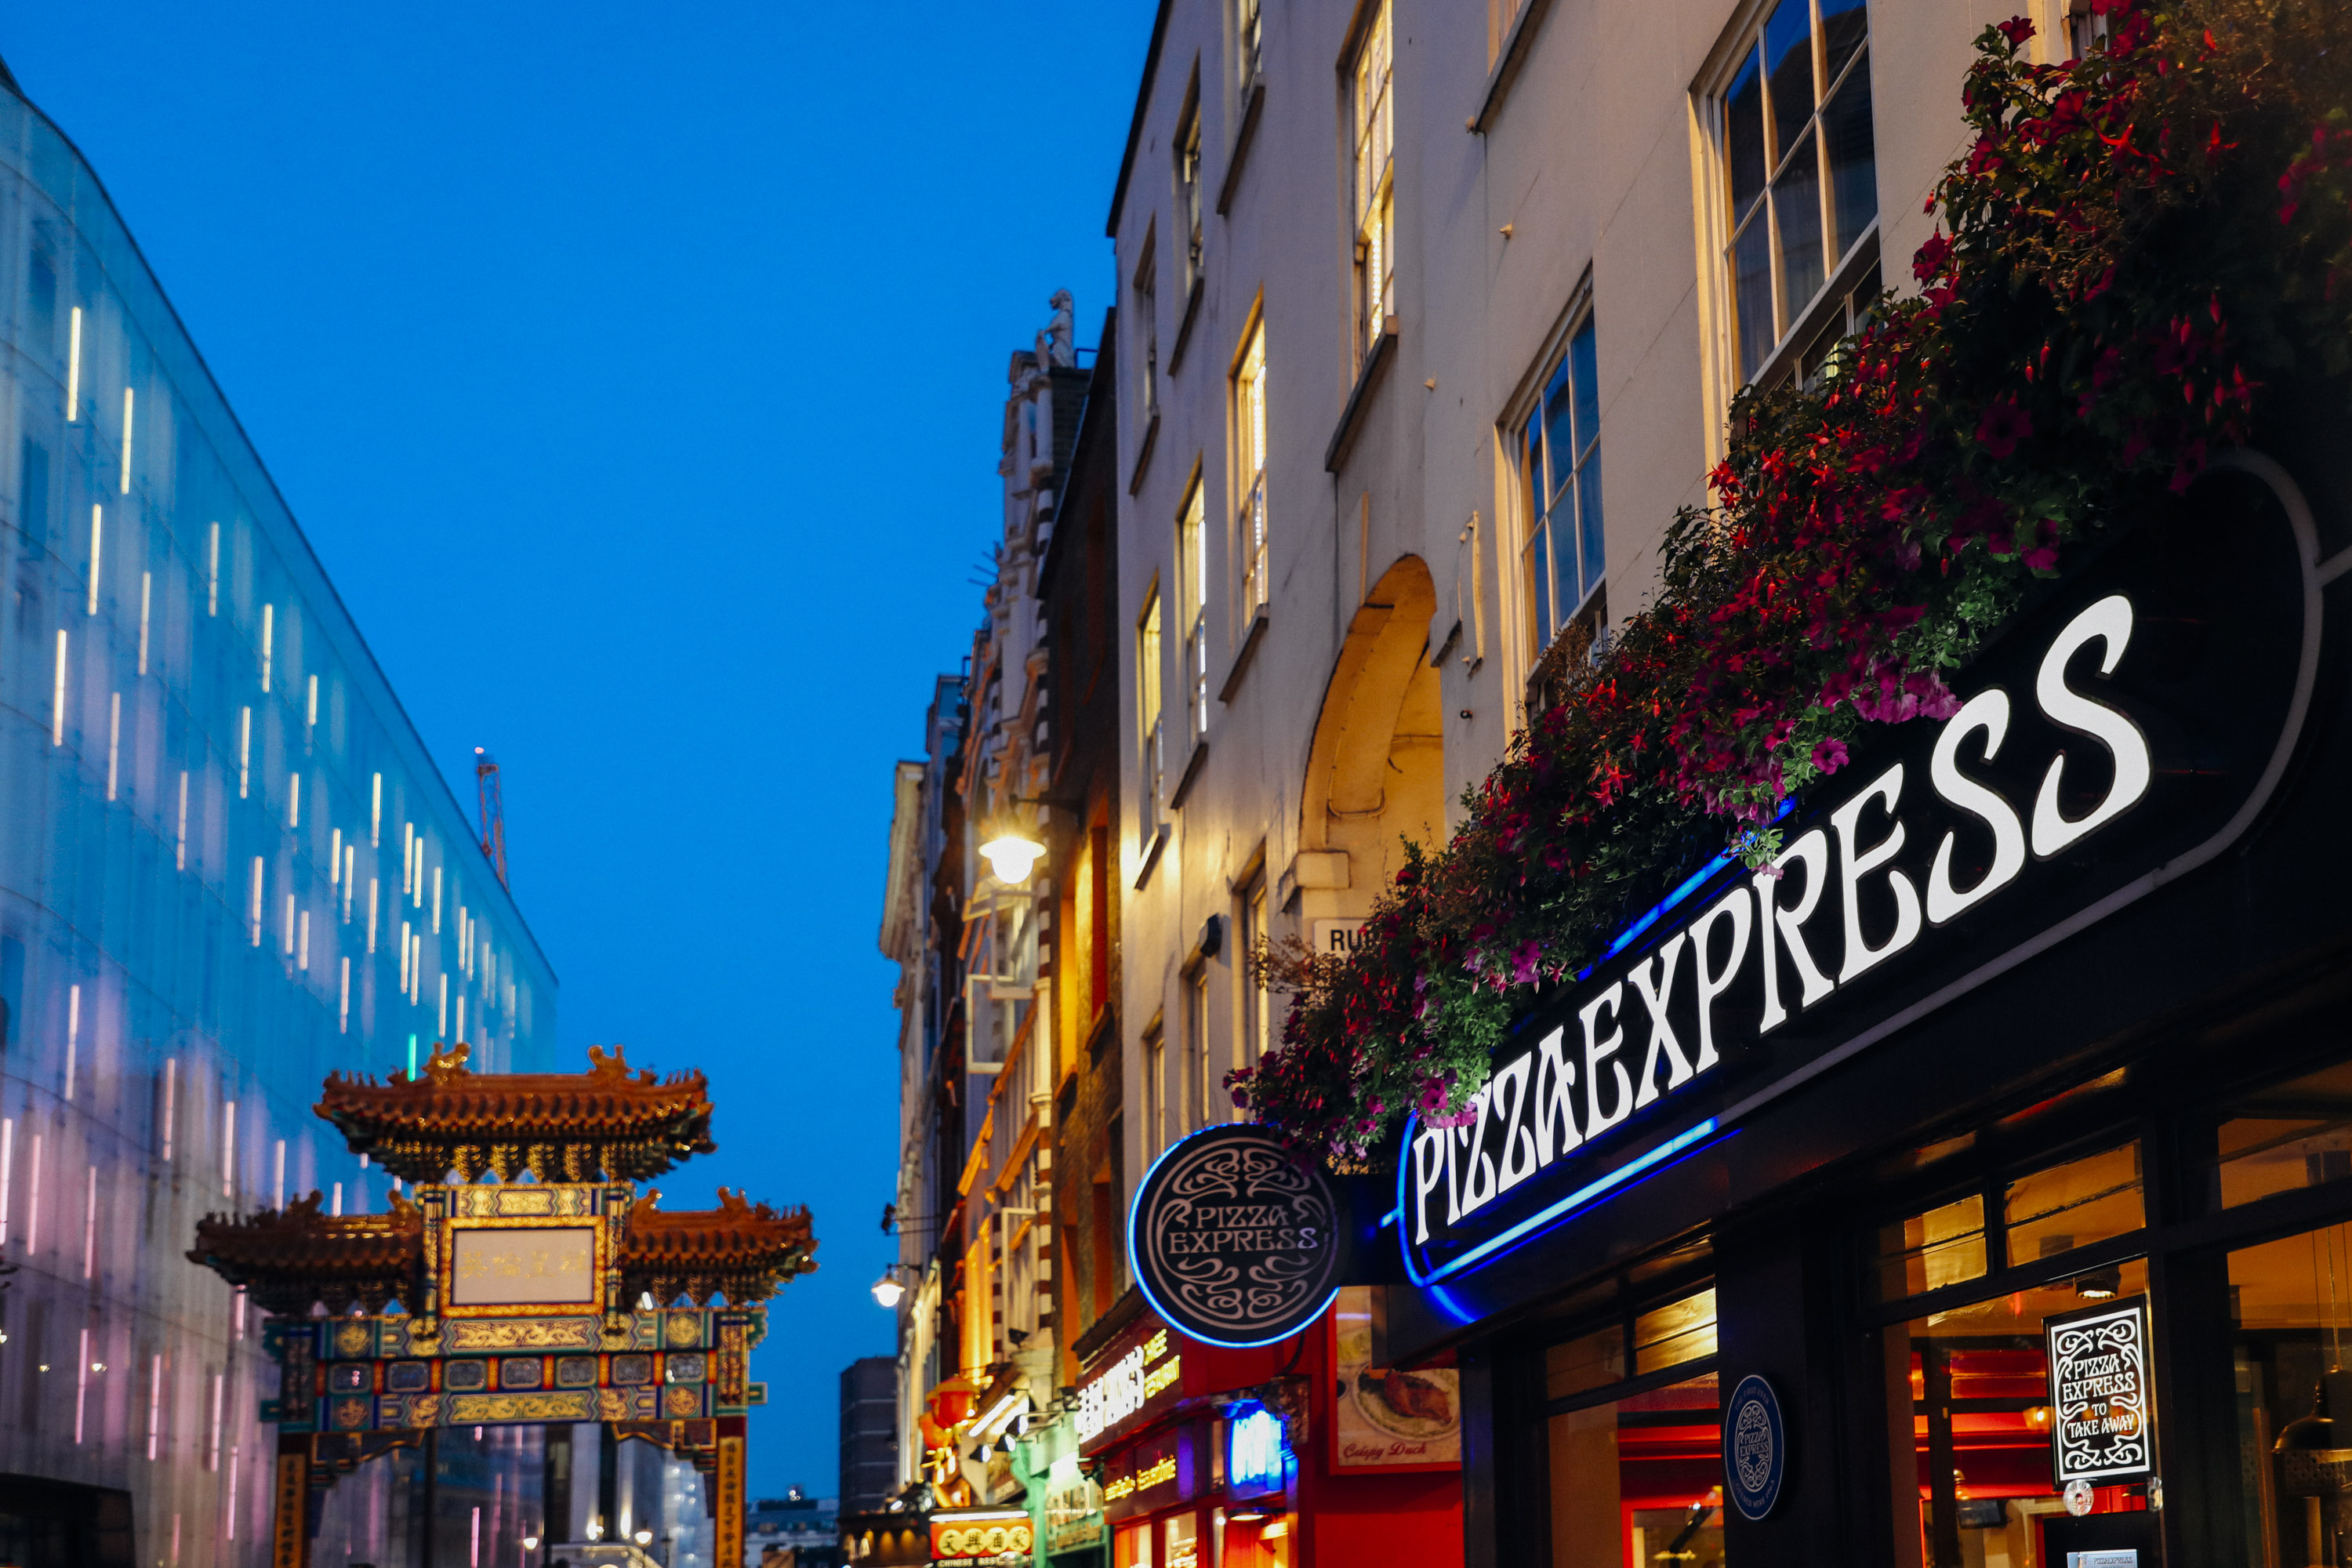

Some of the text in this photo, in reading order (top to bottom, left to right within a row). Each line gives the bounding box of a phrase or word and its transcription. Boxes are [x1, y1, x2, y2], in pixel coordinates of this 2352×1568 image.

[1414, 595, 2151, 1246] PIZZAEXPRESS
[1196, 1205, 1289, 1229] PIZZA
[1169, 1228, 1318, 1254] EXPRESS
[2074, 1354, 2121, 1380] PIZZA
[1743, 1386, 1757, 1398] FIRST
[2063, 1371, 2136, 1403] EXPRESS
[2092, 1403, 2107, 1417] TO
[2067, 1414, 2136, 1439] TAKE AWAY
[1744, 1431, 1763, 1445] PIZZA
[1343, 1442, 1428, 1461] Crispy Duck
[1740, 1441, 1769, 1457] EXPRESS
[937, 1558, 974, 1568] CHINESE
[2094, 1556, 2133, 1565] PIZZAEXPRESS
